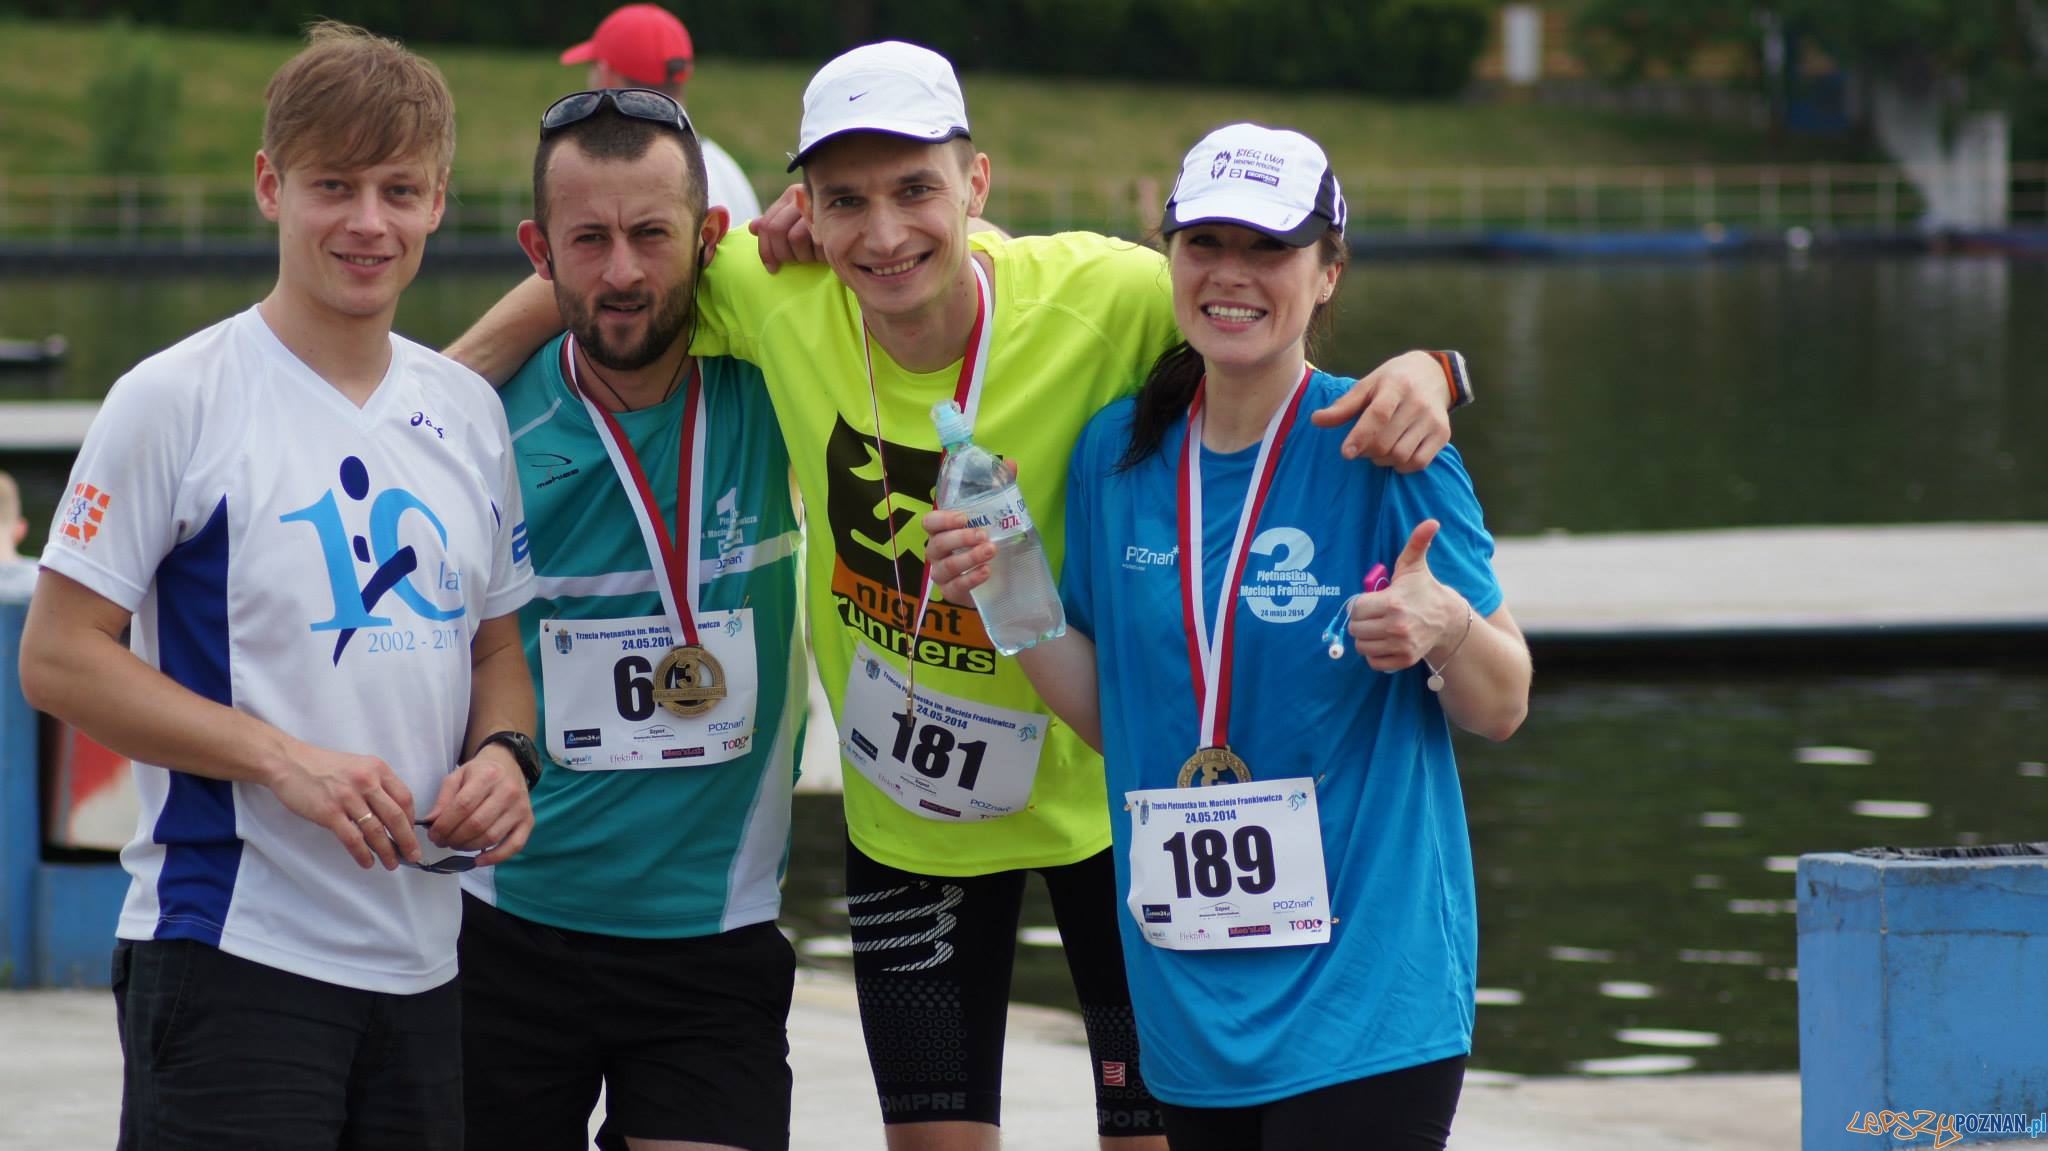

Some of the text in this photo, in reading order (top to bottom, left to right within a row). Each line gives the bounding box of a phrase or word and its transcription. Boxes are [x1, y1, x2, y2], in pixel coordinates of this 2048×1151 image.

[1277, 585, 1340, 597] Frankiewicza
[857, 582, 961, 636] night
[368, 630, 415, 653] 2002
[622, 636, 675, 651] 24.05.2014
[834, 596, 994, 674] runners
[916, 704, 969, 730] 24.05.2014
[891, 711, 988, 791] 181
[1209, 797, 1237, 808] Macieja
[1238, 794, 1282, 806] Frankiewicza
[1185, 809, 1237, 824] 24.05.2014
[1163, 825, 1276, 899] 189
